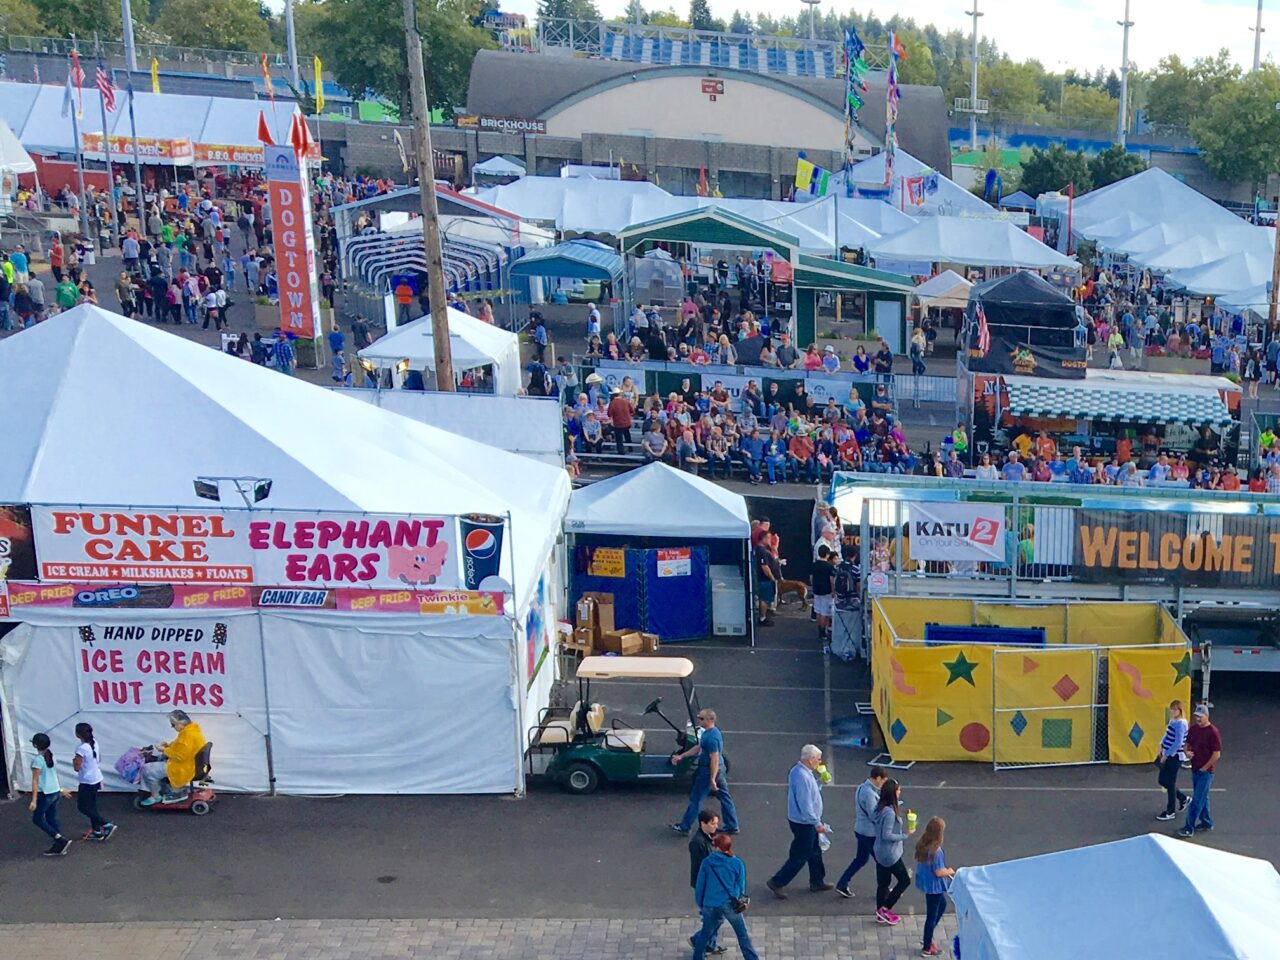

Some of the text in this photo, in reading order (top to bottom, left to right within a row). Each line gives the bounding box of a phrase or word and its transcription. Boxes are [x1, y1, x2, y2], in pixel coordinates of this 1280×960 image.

[480, 118, 544, 131] BRICKHOUSE
[233, 152, 264, 161] CHICKEN
[279, 188, 303, 328] DOGTOWN
[706, 386, 740, 398] KTU
[52, 512, 235, 538] FUNNEL
[248, 520, 445, 549] ELEPHANT
[916, 521, 993, 541] KATU 2
[84, 539, 209, 562] CAKE
[934, 539, 951, 547] Your
[1080, 525, 1254, 573] WELCOME
[48, 565, 248, 580] ICE CREAM MILKSHAKES FLOATS
[285, 552, 380, 583] EARS
[466, 556, 477, 585] pepsi
[10, 586, 469, 610] DEEP FRIED OREO DEEP FRIED CANDY BAR DEEP FRIED Twinkie
[103, 626, 204, 642] HAND DIPPED
[81, 648, 225, 676] ICE CREAM
[93, 680, 225, 708] NUT BARS
